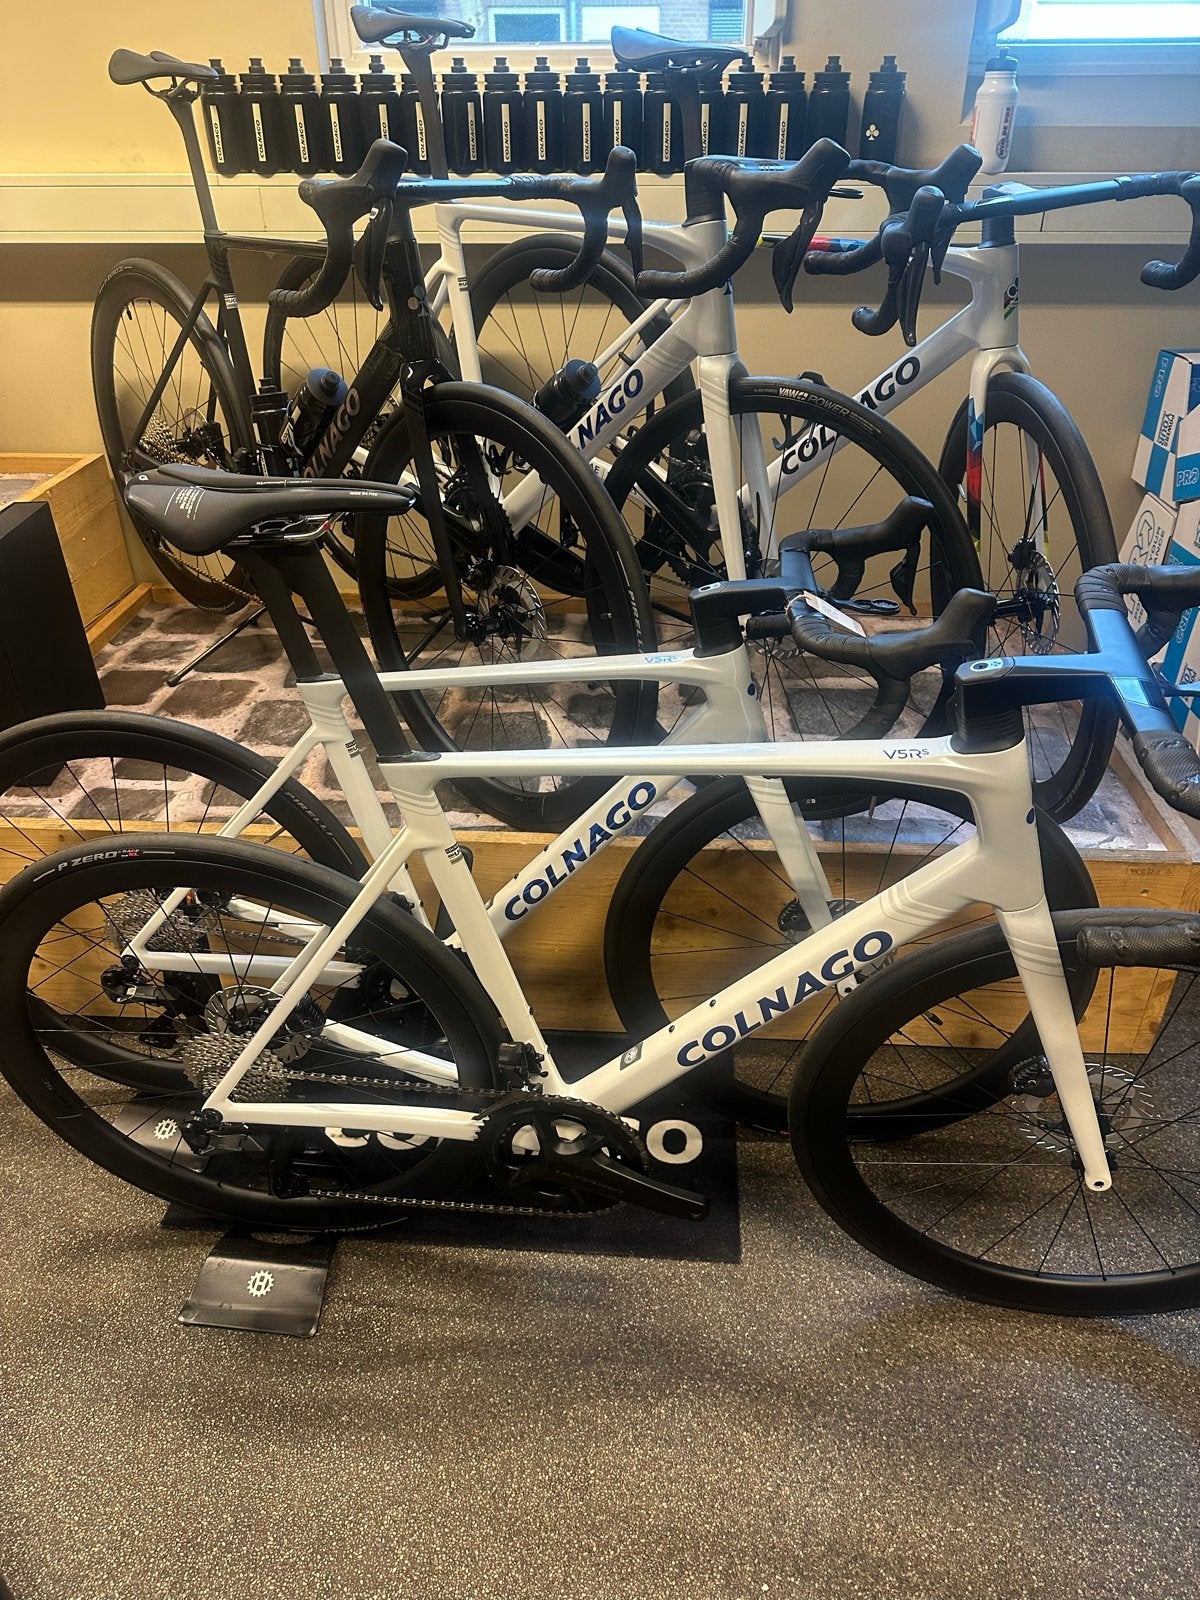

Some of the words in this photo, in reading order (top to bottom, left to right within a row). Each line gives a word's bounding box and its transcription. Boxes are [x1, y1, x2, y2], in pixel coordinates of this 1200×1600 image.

[213, 122, 223, 161] COLNAGO
[255, 119, 265, 159] COLNAGO
[297, 121, 308, 161] COLNAGO
[332, 120, 342, 160] COLNAGO
[417, 119, 426, 159] COLNAGO
[469, 119, 478, 159] COLNAGO
[503, 121, 511, 160] COLNAGO
[538, 119, 546, 158] COLNAGO
[577, 367, 644, 451] NAGO
[781, 356, 921, 475] COLAGO
[808, 394, 850, 418] POWER
[303, 386, 361, 479] LNAGO
[1176, 467, 1200, 487] PRO
[58, 862, 68, 871] P
[71, 851, 118, 867] ZERO
[504, 781, 657, 921] COLNAGO
[676, 930, 894, 1067] COLNAGO
